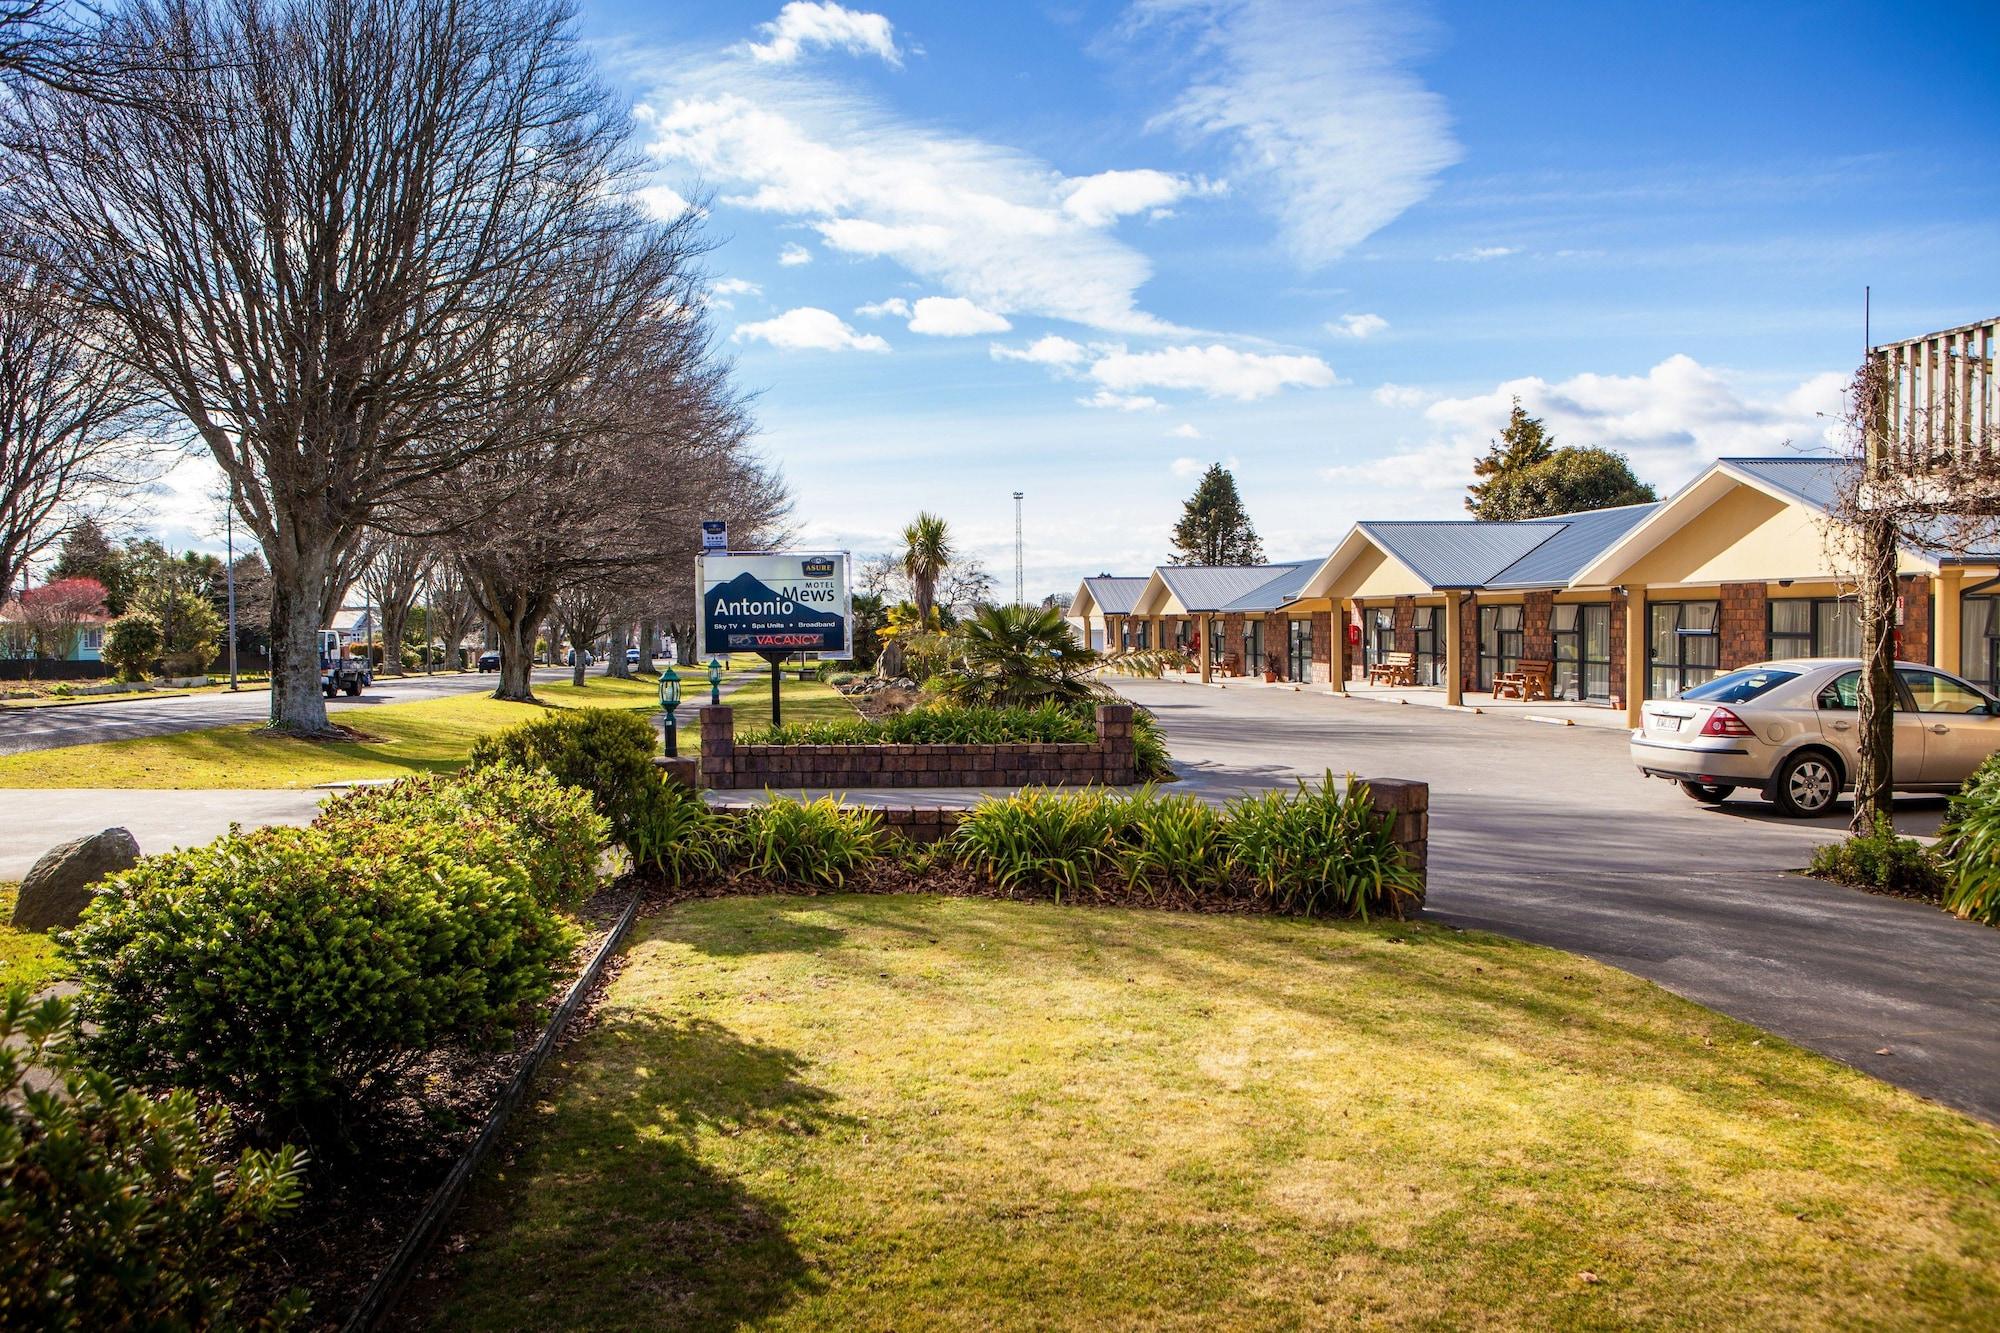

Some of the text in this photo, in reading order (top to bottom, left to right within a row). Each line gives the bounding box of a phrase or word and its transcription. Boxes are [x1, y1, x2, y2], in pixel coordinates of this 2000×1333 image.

[782, 586, 835, 602] Mews
[714, 597, 794, 616] Antonio
[714, 623, 726, 631] Sky
[756, 634, 820, 645] VACANCY
